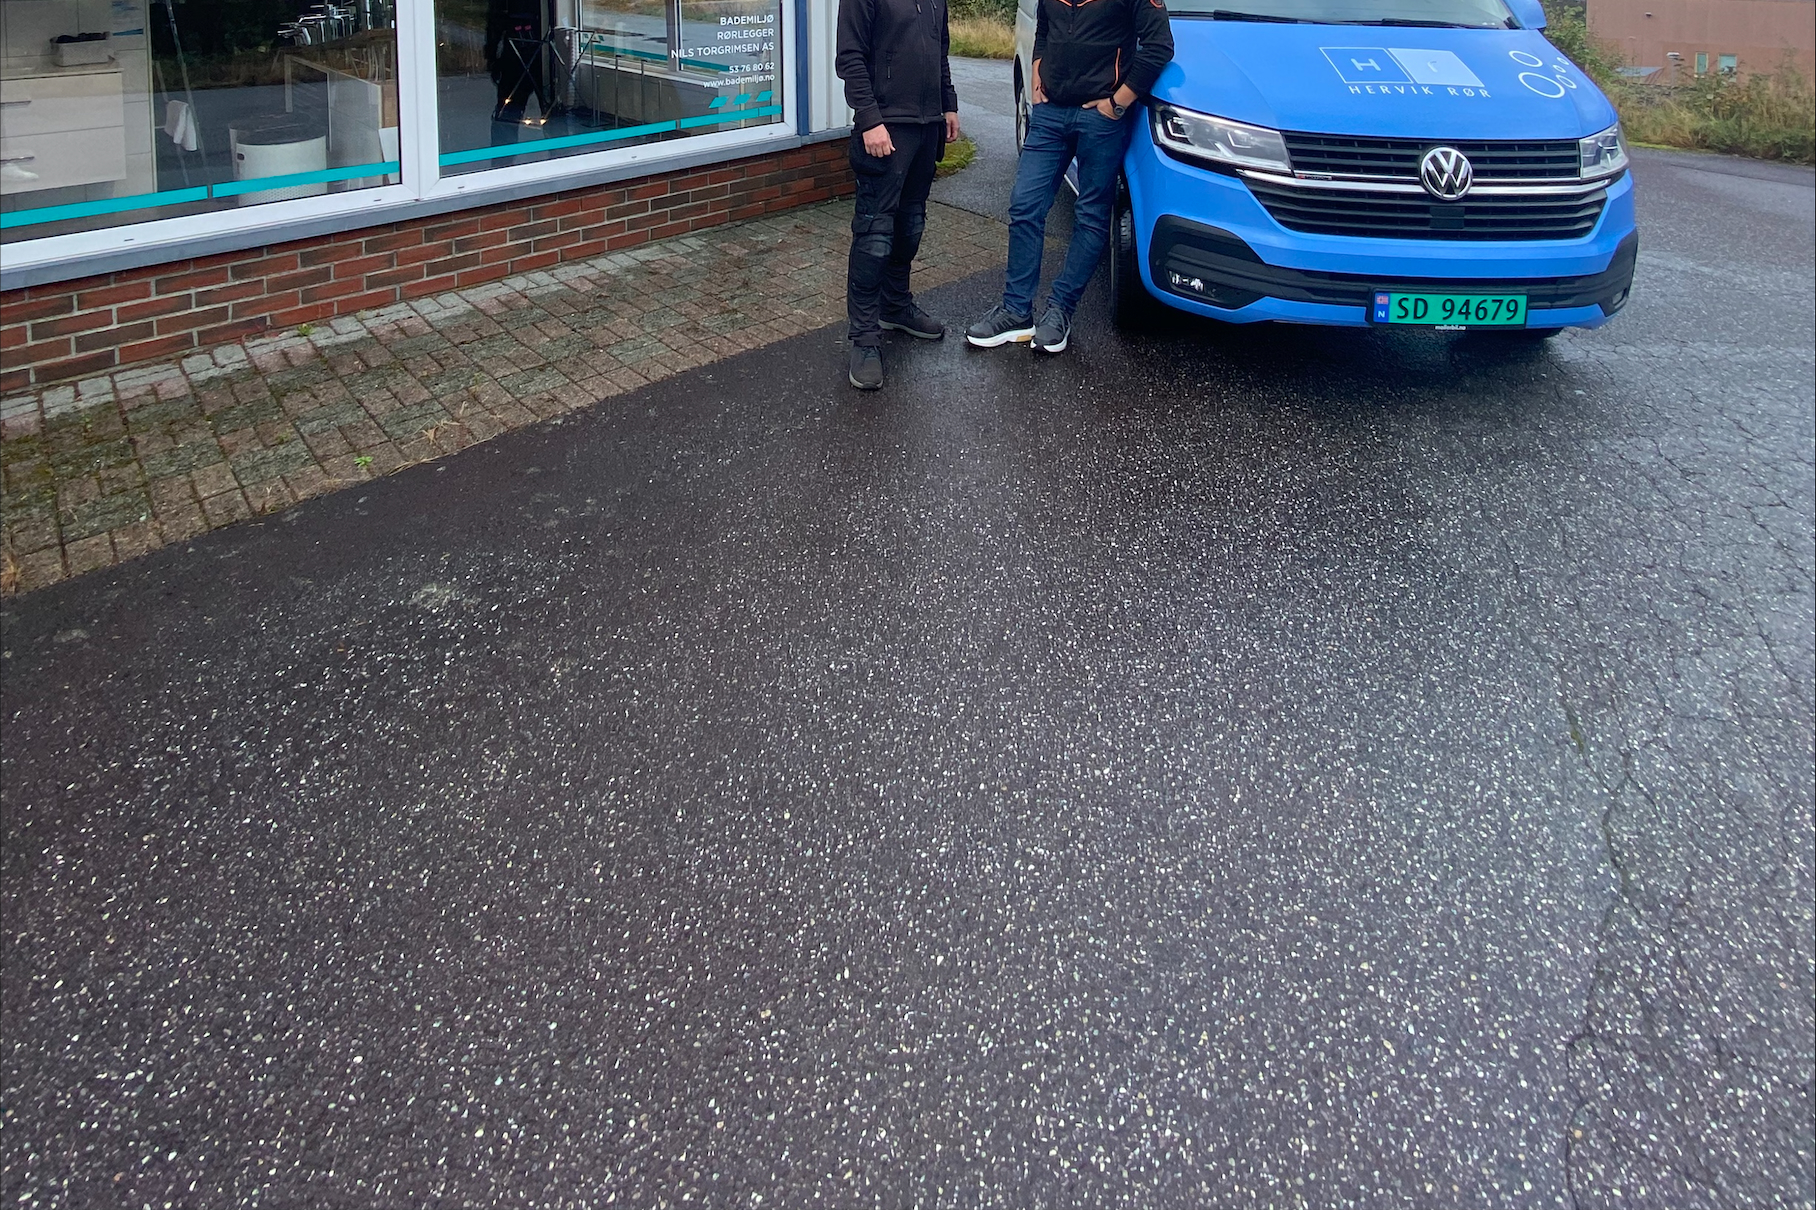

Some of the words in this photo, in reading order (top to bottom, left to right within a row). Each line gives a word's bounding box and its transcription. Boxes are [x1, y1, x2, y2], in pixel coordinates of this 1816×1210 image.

[720, 14, 774, 26] BADEMILJØ
[717, 28, 775, 40] RØRLEGGER
[671, 48, 695, 59] NILS
[697, 43, 760, 57] TORGRIMSEN
[762, 41, 775, 51] AS
[729, 65, 739, 74] 53
[740, 64, 751, 72] 76
[753, 63, 763, 71] 80
[765, 62, 775, 71] 62
[1350, 58, 1382, 72] H
[703, 74, 775, 88] www.bademiljø.no
[1349, 85, 1434, 96] HERVIK
[1447, 86, 1492, 98] RØR
[1377, 310, 1385, 318] N
[1397, 297, 1429, 320] SD
[1441, 298, 1519, 321] 94679
